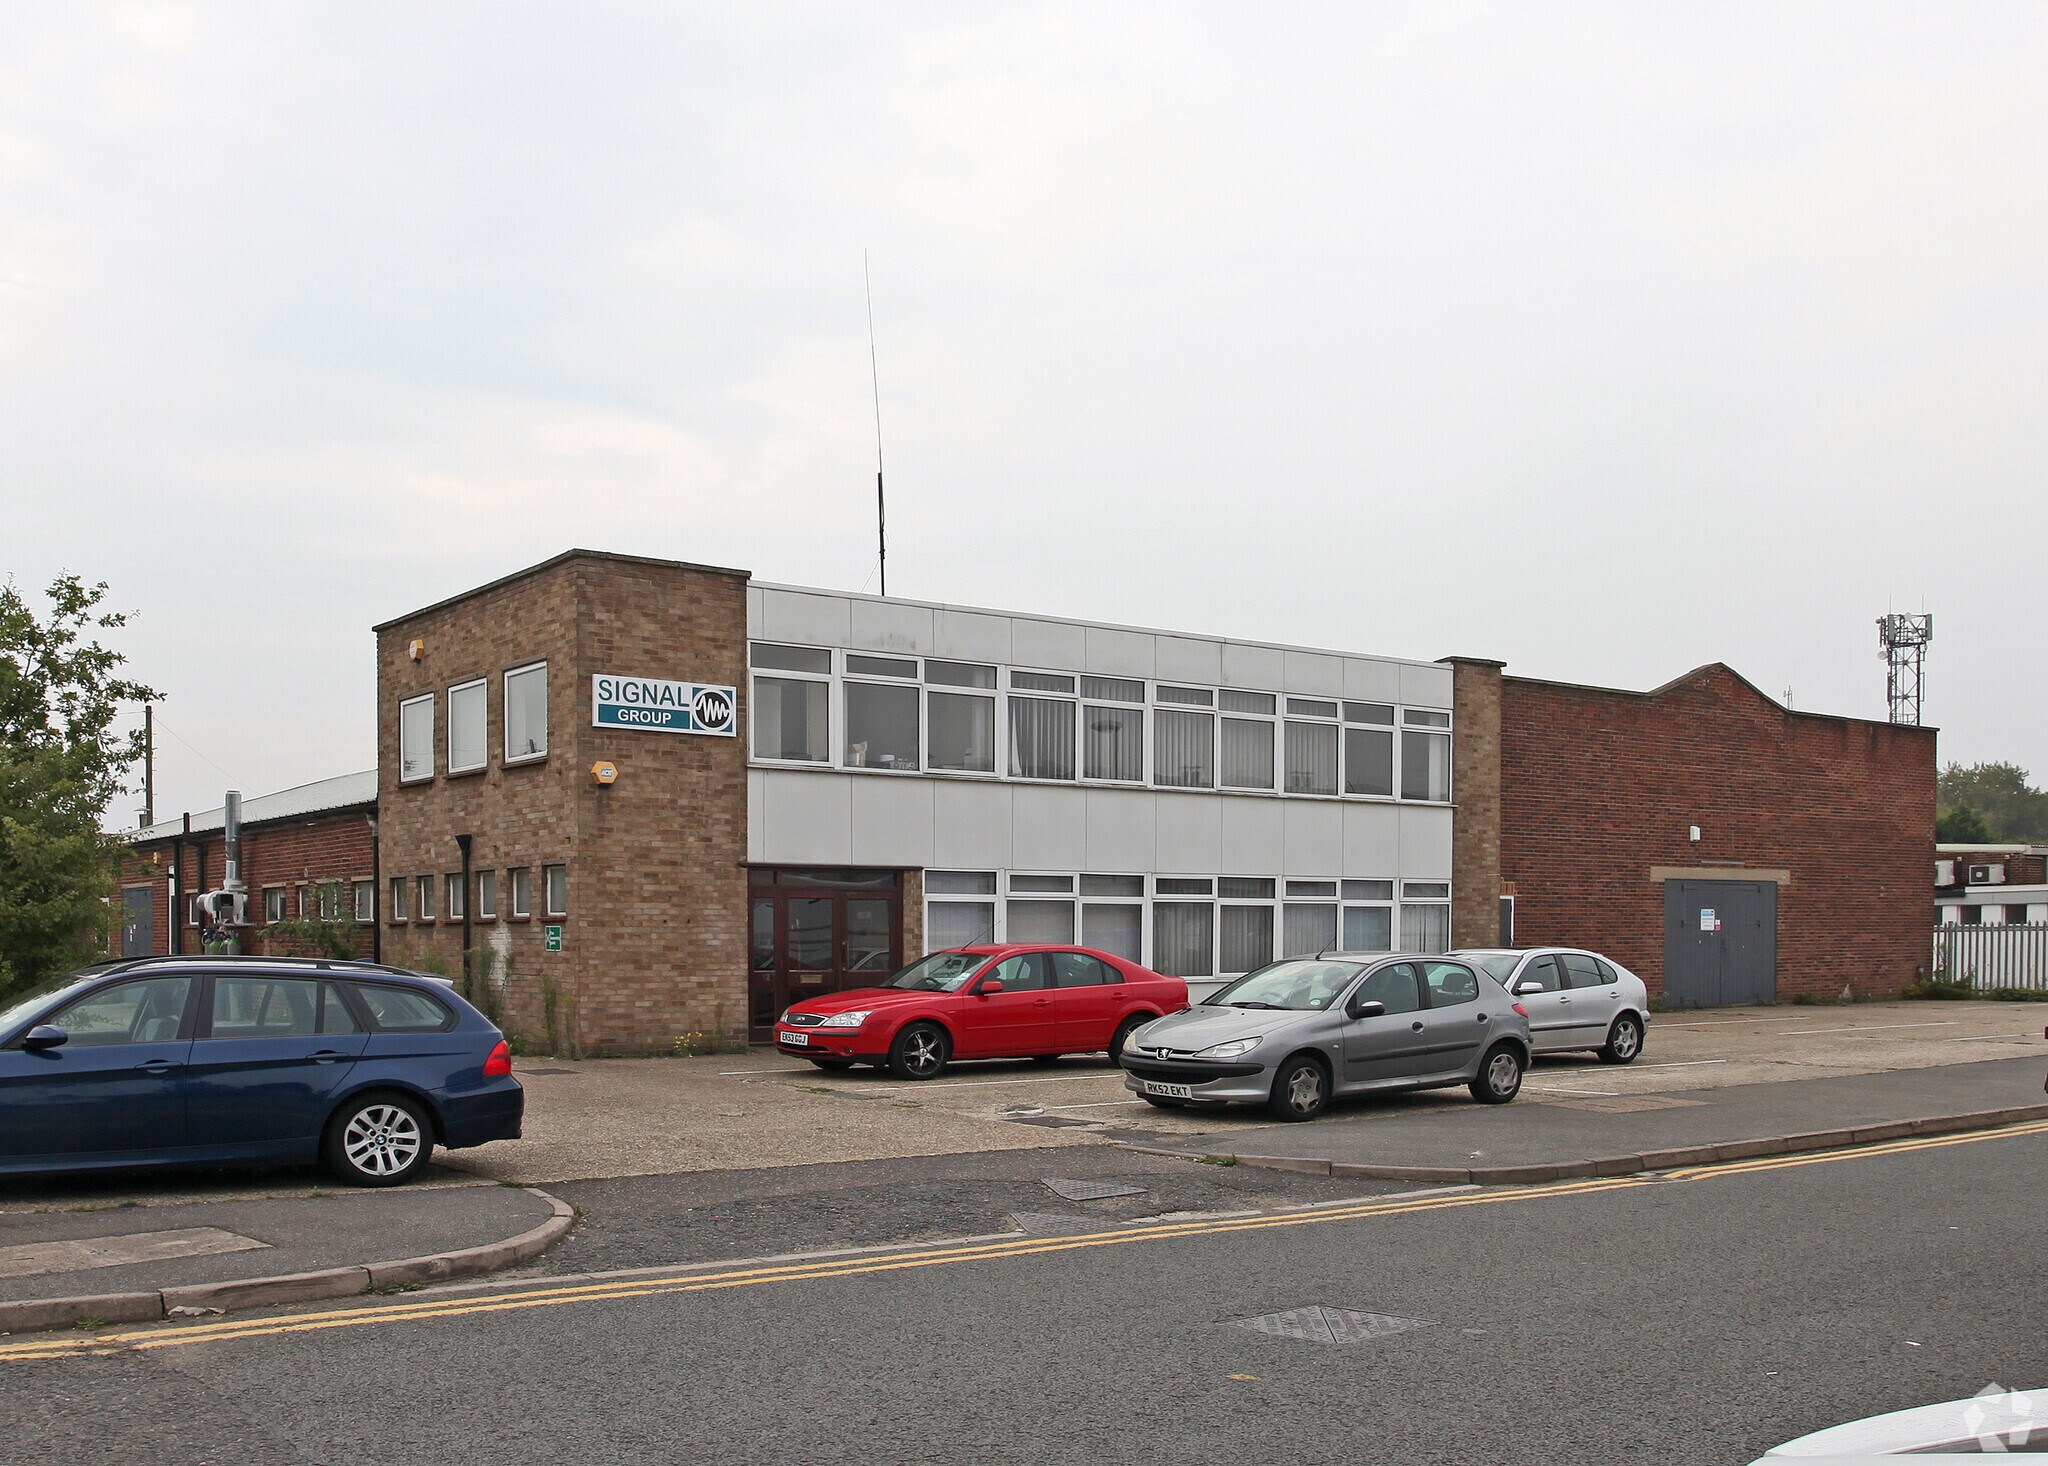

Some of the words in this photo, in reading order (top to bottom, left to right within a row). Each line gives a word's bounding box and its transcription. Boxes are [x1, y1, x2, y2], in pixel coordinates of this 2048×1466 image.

[598, 679, 690, 707] SIGNAL
[617, 708, 672, 725] GROUP
[782, 1032, 794, 1042] EK53
[1147, 1083, 1170, 1095] RK52
[1170, 1086, 1187, 1096] EKT
